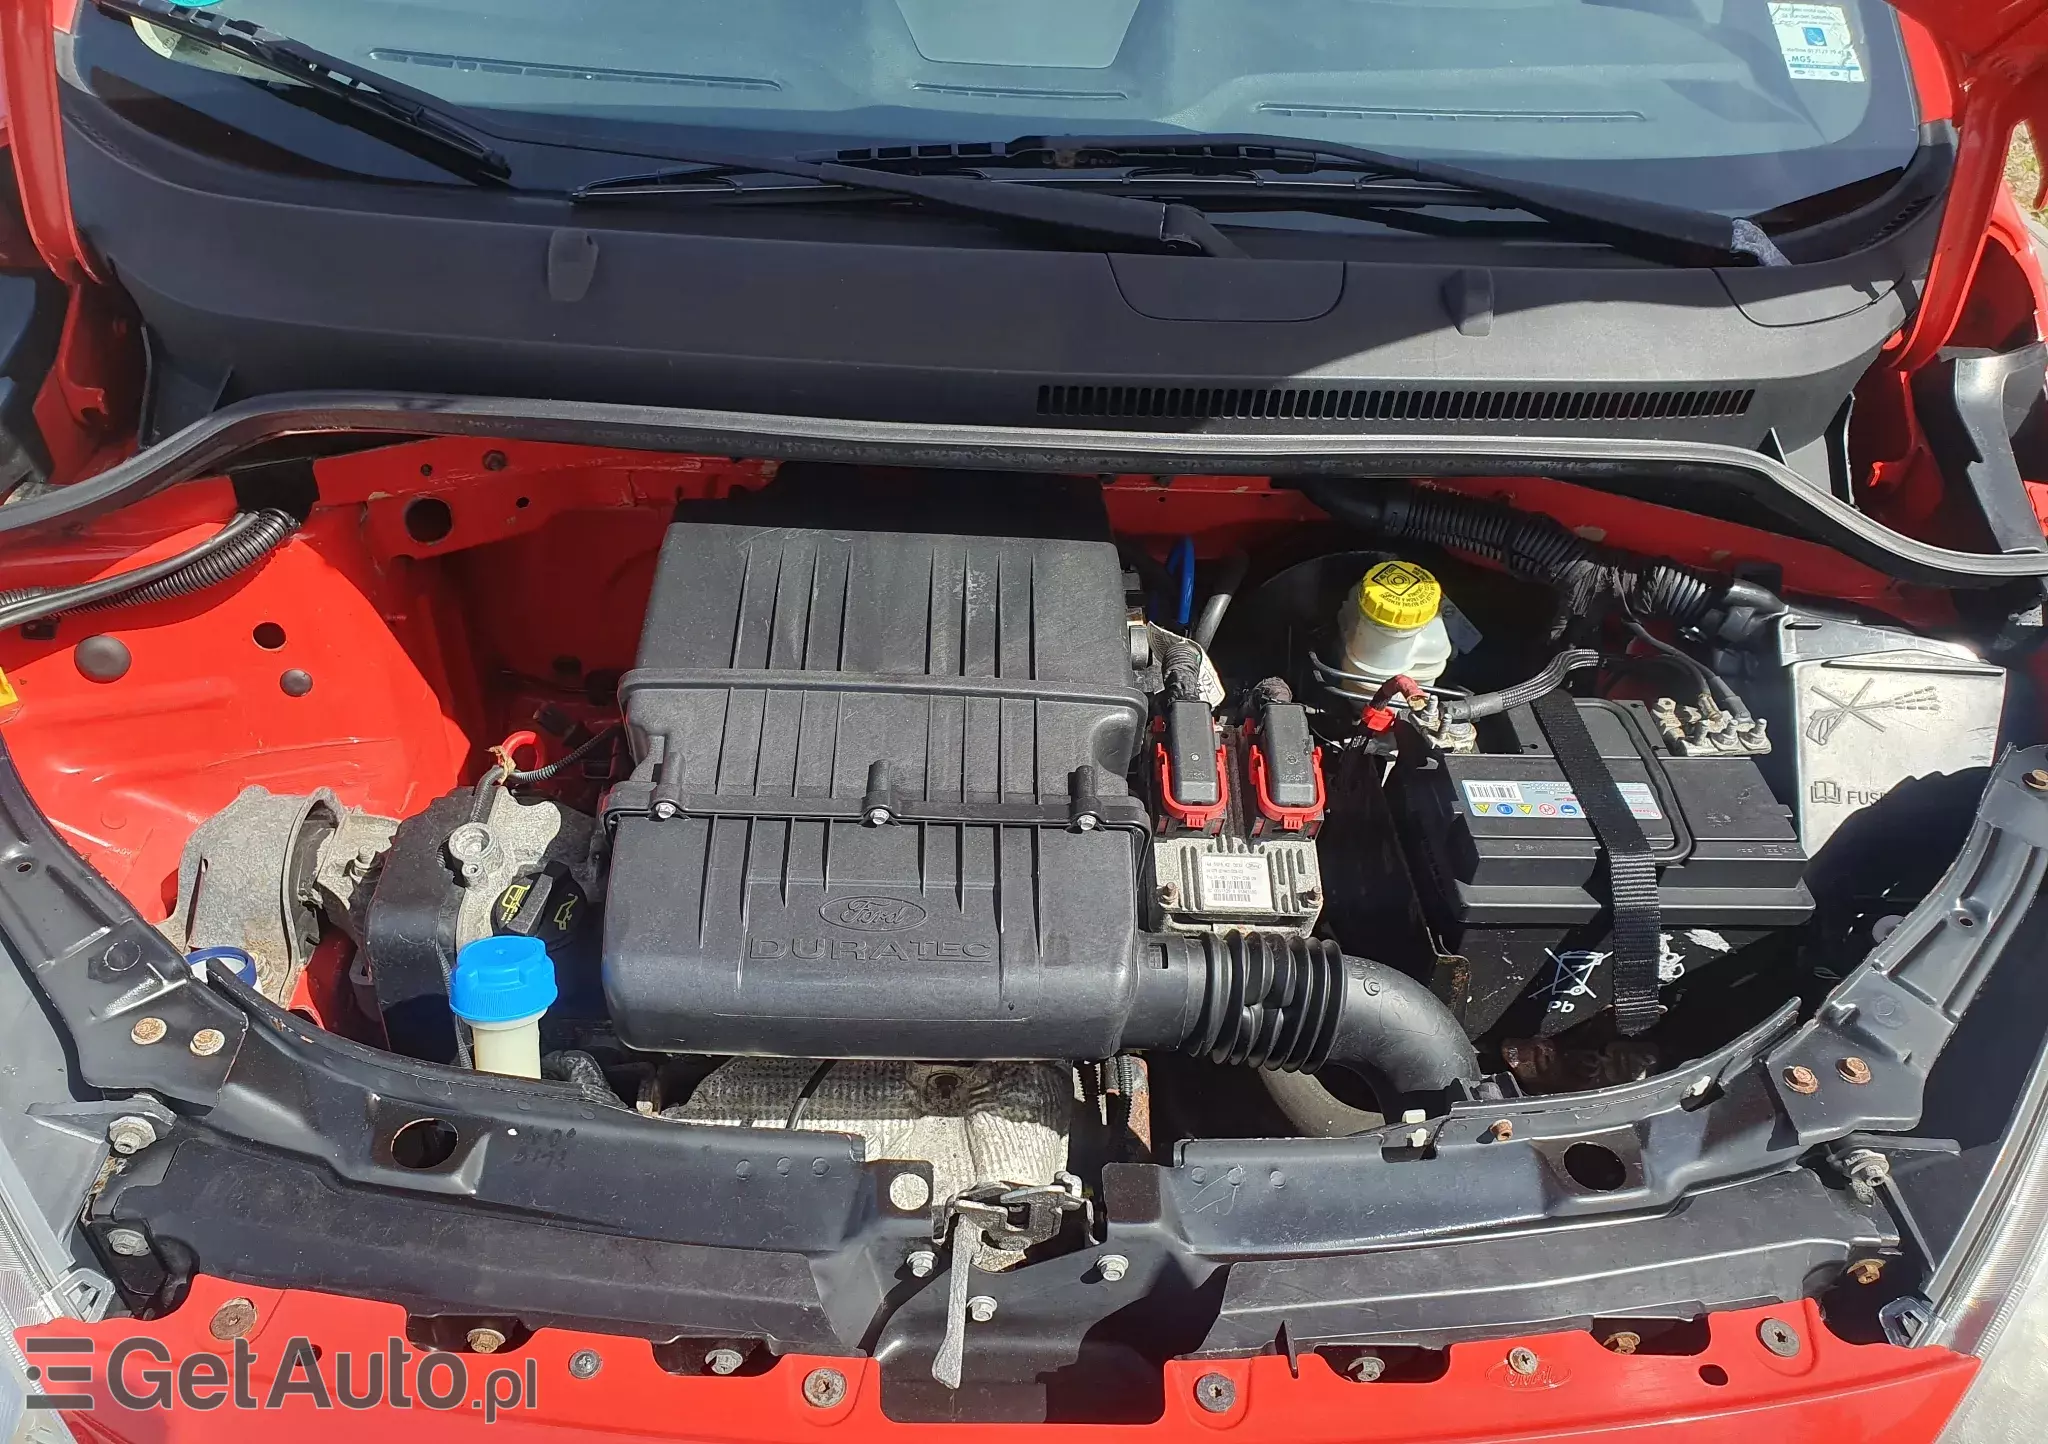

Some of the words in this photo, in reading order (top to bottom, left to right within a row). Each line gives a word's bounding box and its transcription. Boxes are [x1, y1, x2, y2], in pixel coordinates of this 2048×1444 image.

[840, 900, 908, 925] Ford
[749, 937, 992, 962] DURATEC
[1547, 1001, 1575, 1013] Pb
